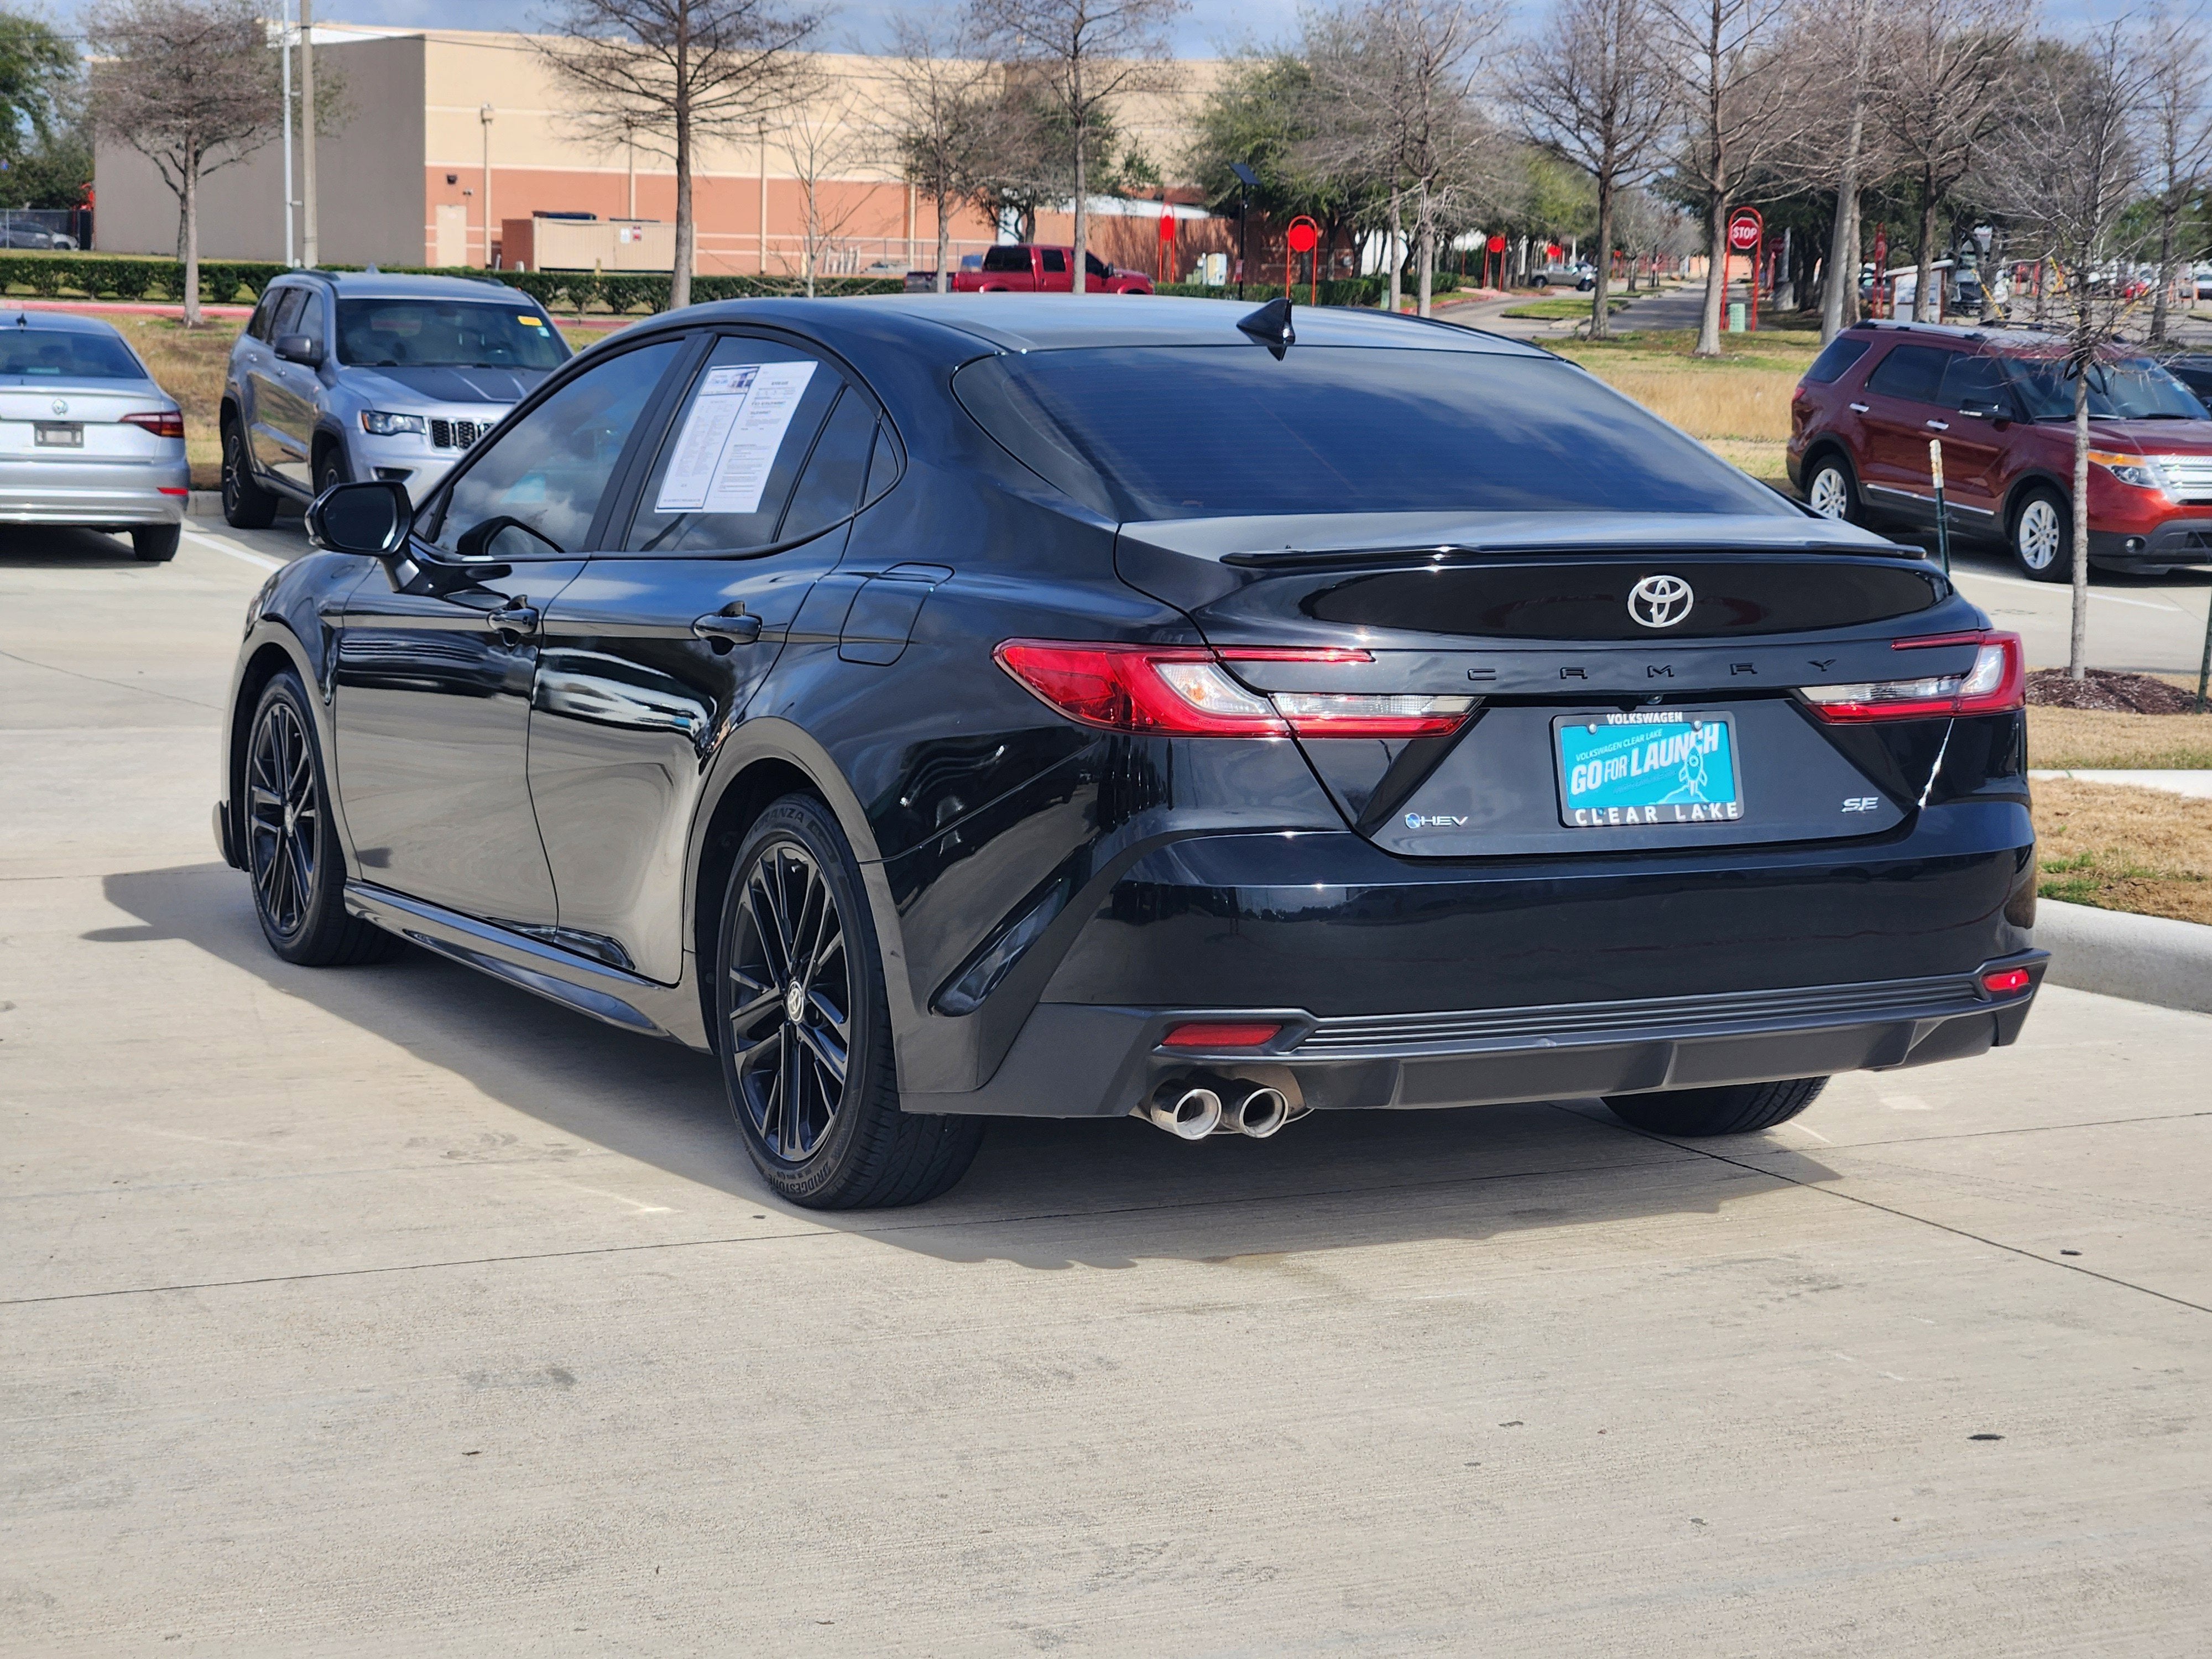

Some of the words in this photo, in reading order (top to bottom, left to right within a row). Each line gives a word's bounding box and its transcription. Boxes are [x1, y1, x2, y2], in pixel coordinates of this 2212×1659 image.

[1733, 226, 1757, 239] STOP
[1467, 659, 1836, 681] CAMRY
[1606, 712, 1683, 725] VOLKSWAGEN
[1575, 742, 1624, 762] VOLKSWAGEN
[1623, 733, 1644, 748] CLEAR
[1645, 728, 1664, 740] LAKE
[1571, 760, 1603, 795] GO
[1604, 755, 1628, 783] FOR
[1630, 723, 1720, 777] LAUNCH
[1575, 806, 1658, 827] CLEAR
[1674, 801, 1739, 821] LAKE
[1841, 797, 1879, 813] SE
[1420, 816, 1469, 826] HEV
